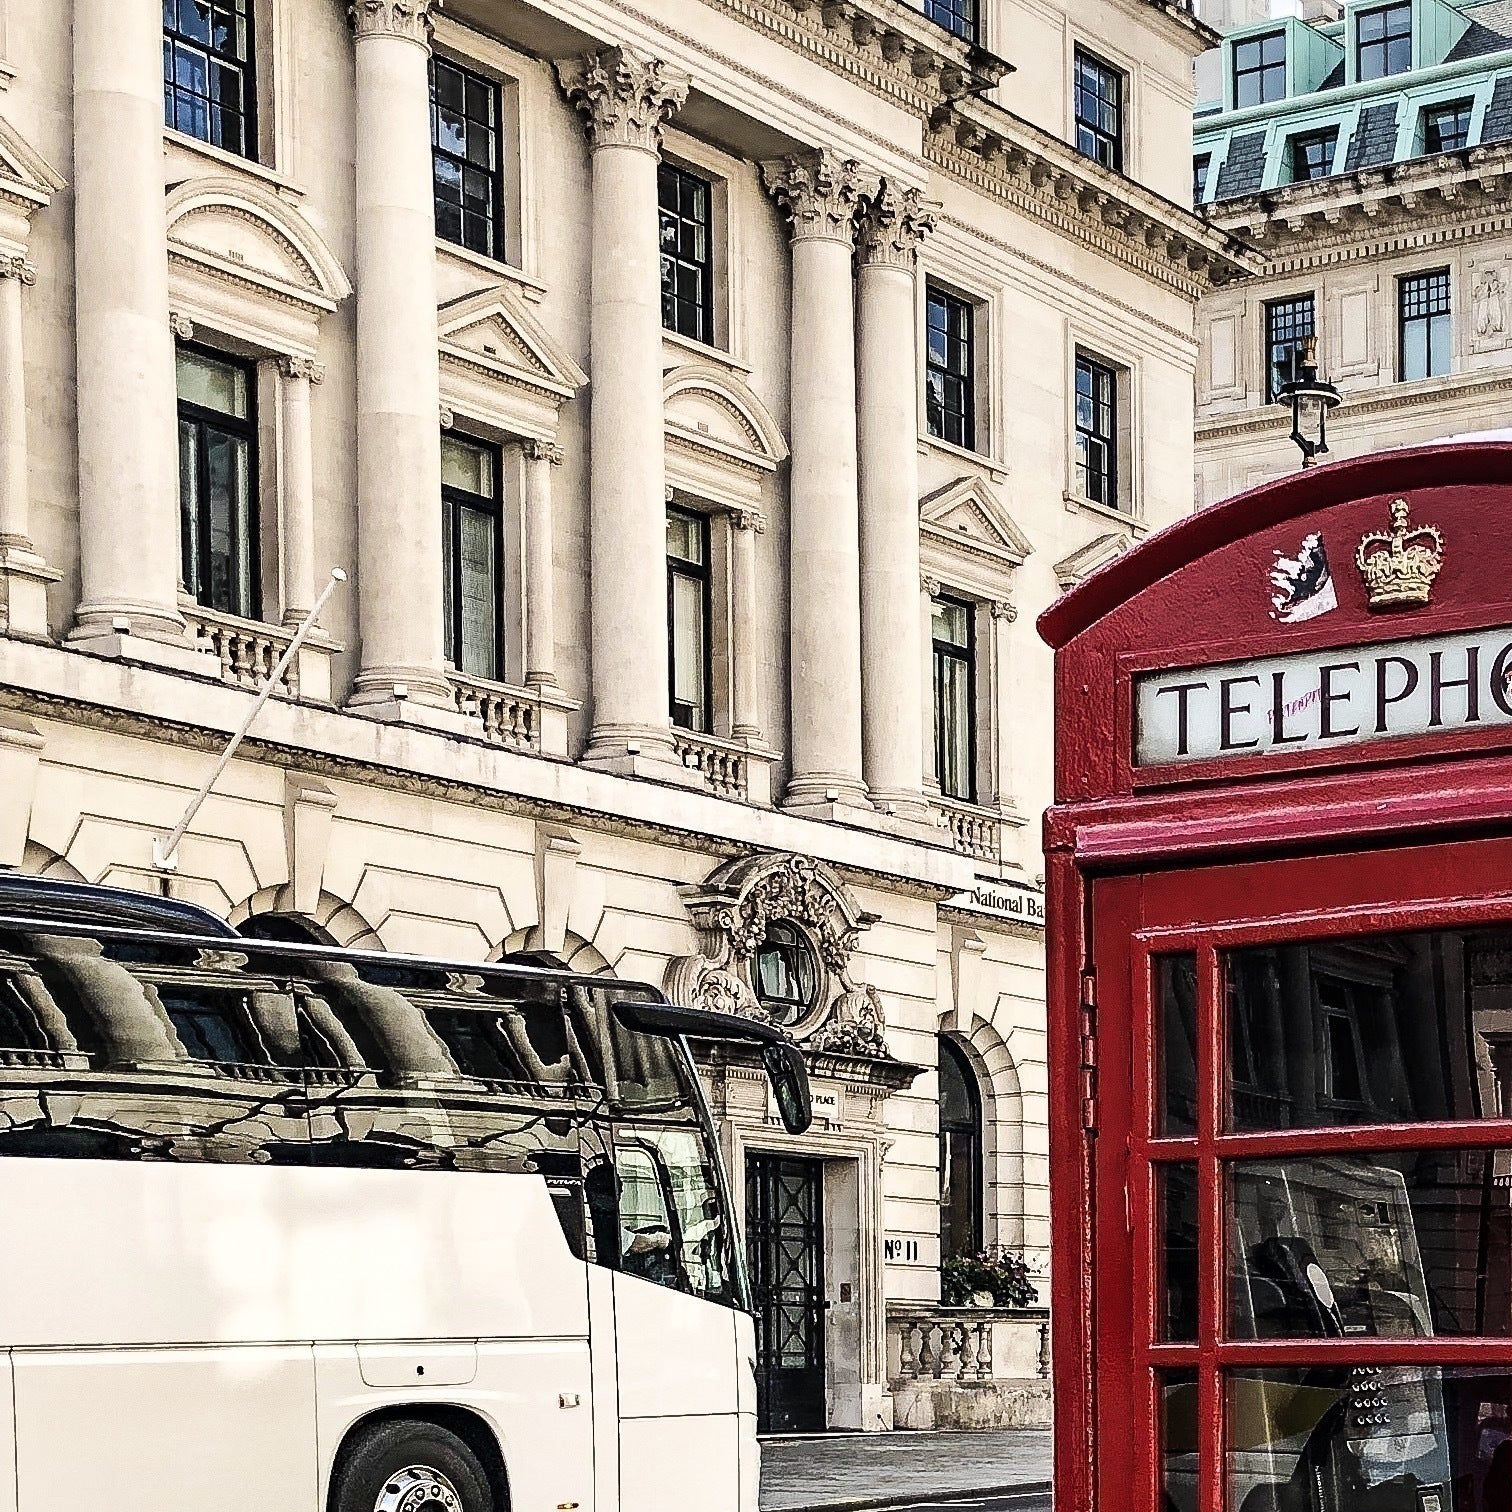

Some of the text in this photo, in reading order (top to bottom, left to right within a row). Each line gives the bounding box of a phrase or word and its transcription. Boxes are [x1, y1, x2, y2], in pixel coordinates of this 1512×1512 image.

[969, 886, 1045, 918] National Ba
[815, 1094, 836, 1105] PLACE
[906, 1240, 918, 1261] 11
